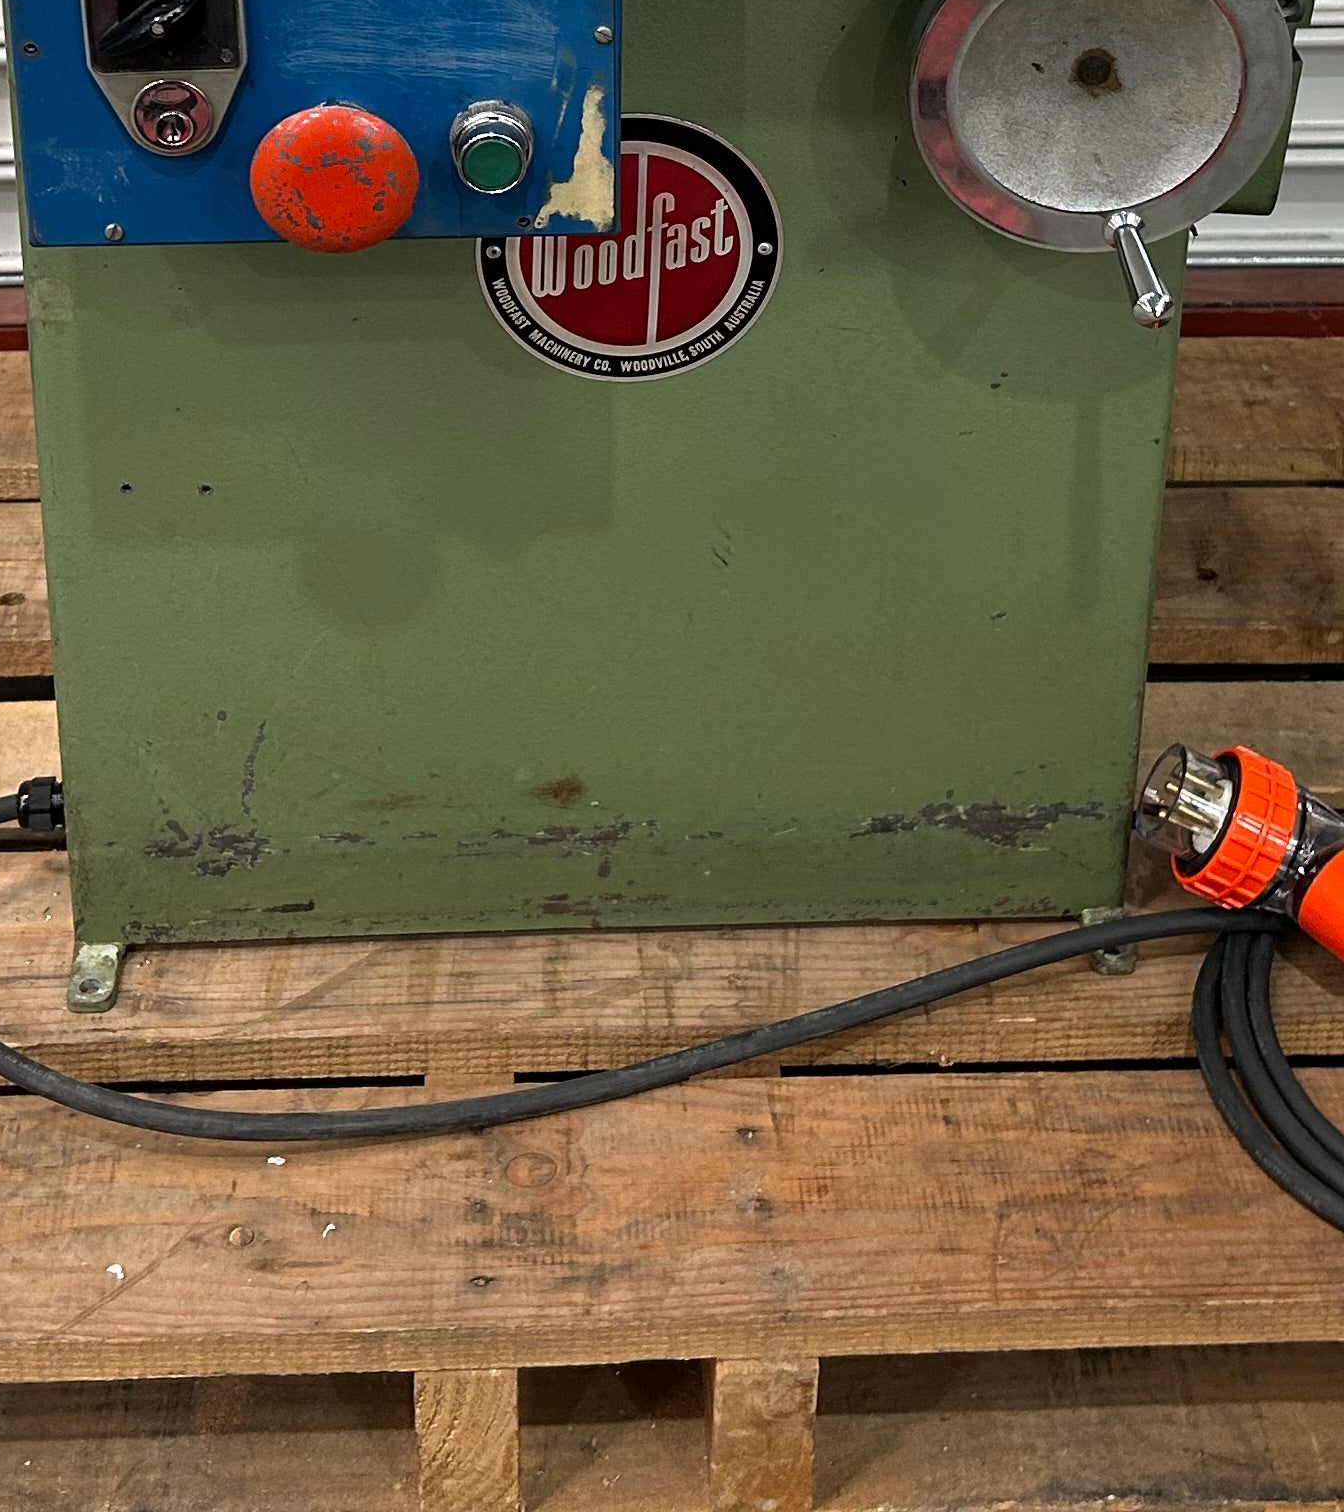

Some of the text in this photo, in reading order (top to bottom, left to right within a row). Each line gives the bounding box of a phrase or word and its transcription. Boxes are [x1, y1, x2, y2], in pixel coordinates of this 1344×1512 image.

[532, 186, 734, 299] Woodfast
[491, 278, 766, 373] WOODFAST MACHINERY CO. WOODVILLE, SOUTH AUSTRALIA
